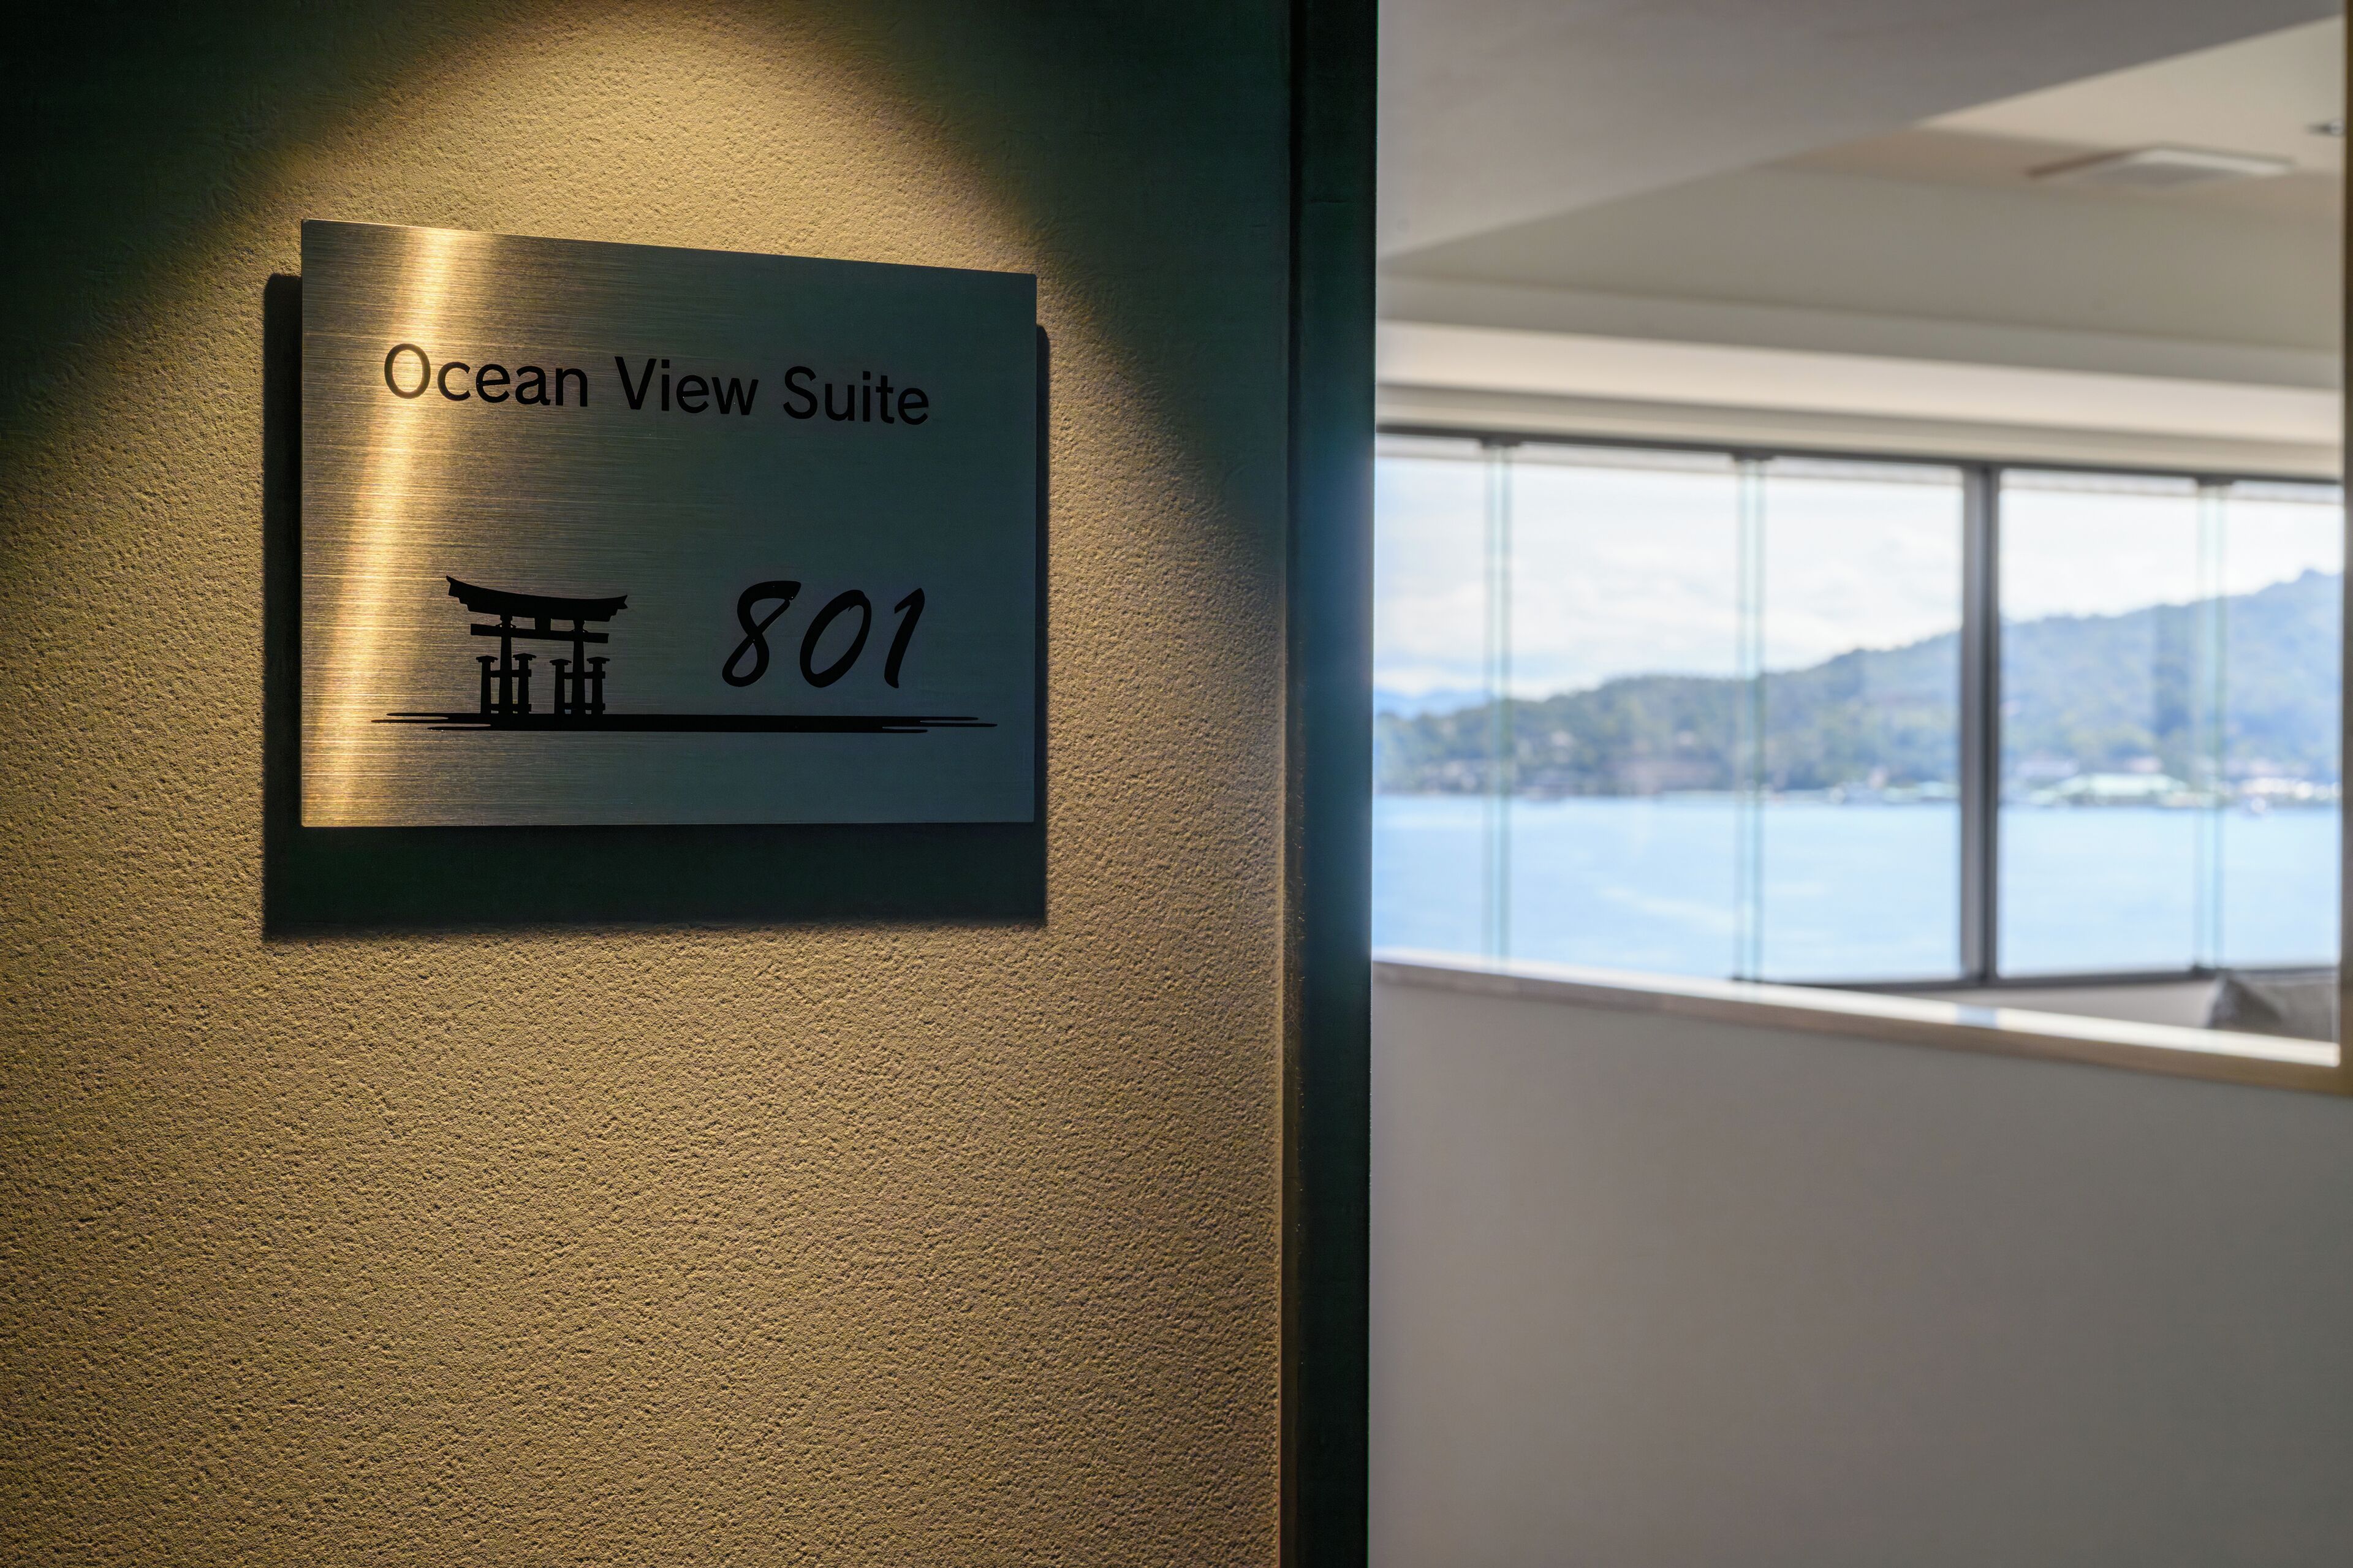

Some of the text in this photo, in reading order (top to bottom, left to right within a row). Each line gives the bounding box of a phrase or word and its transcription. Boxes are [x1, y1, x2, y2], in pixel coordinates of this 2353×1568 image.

[384, 343, 930, 425] Ocean View Suite
[722, 580, 926, 689] 801
